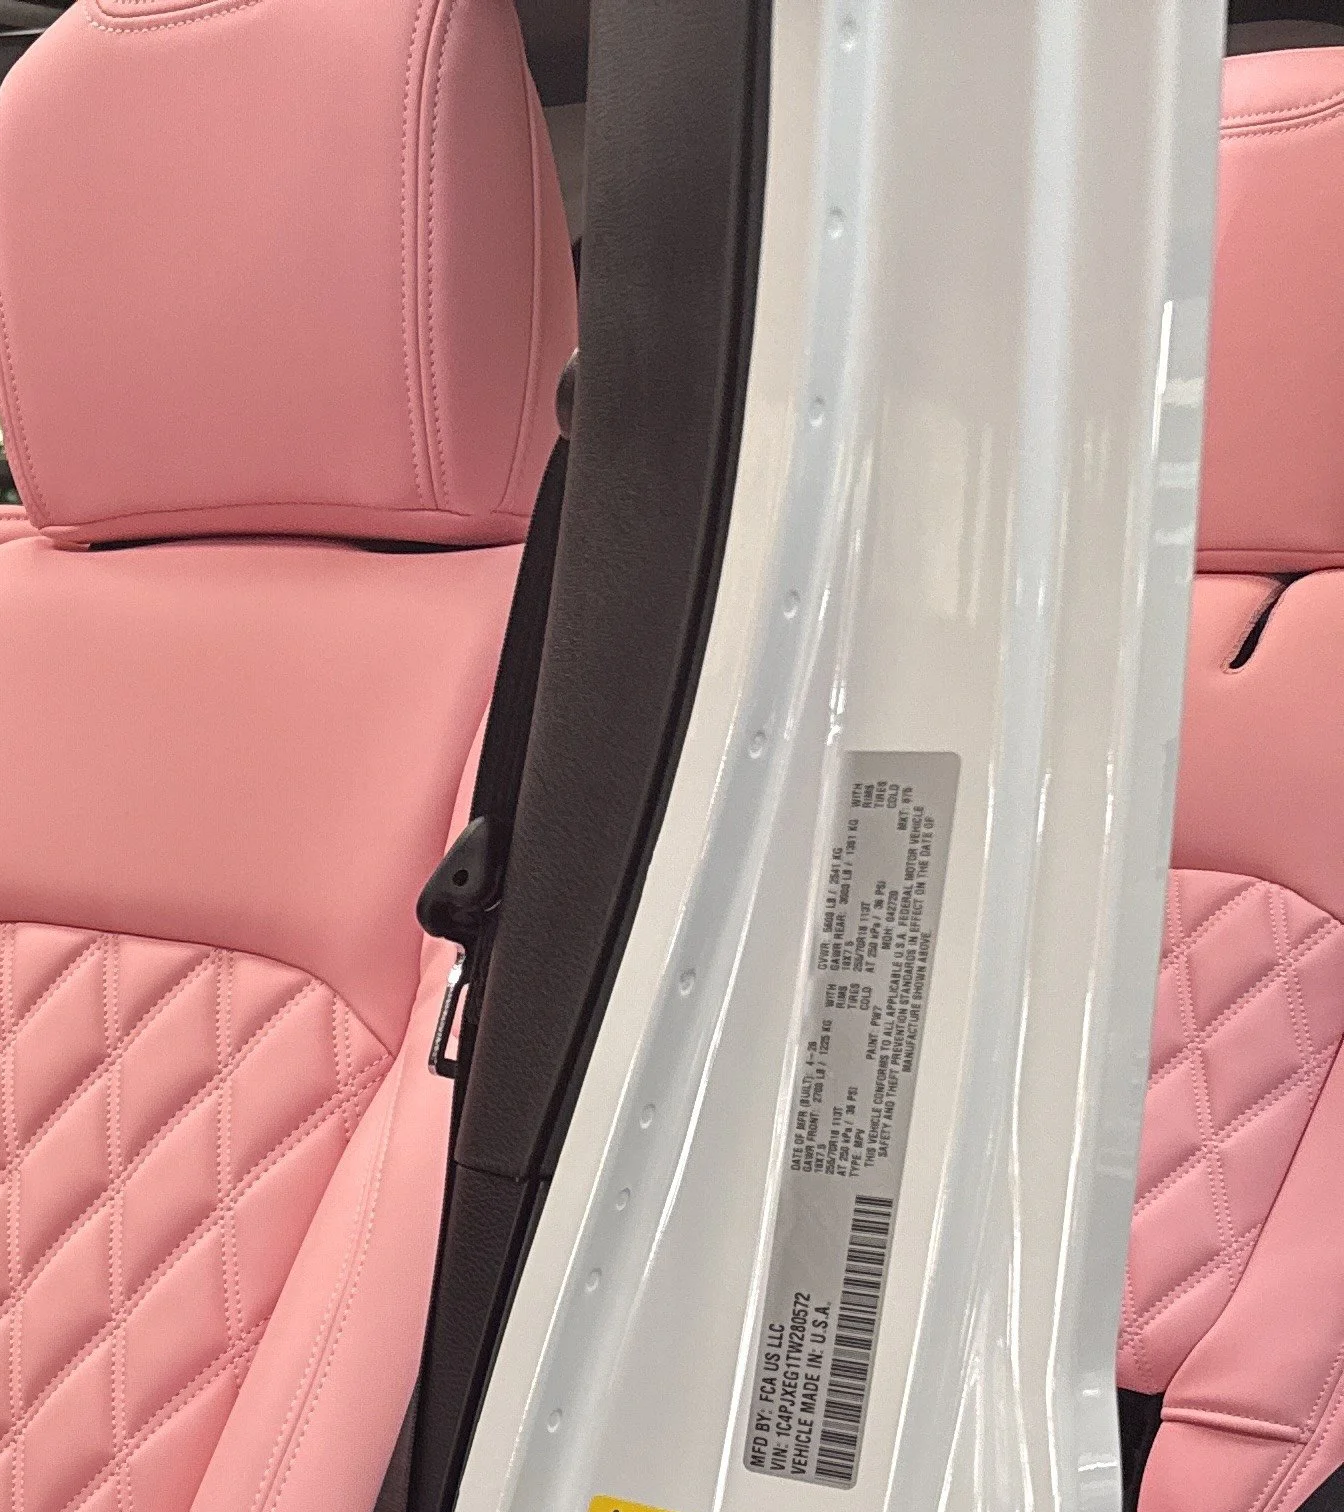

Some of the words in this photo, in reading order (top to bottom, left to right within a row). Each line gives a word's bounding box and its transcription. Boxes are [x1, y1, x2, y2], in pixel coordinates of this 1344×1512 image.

[909, 805, 923, 845] VEHICLE
[922, 815, 935, 829] OF
[919, 831, 931, 857] DATE
[904, 847, 917, 881] MOTOR
[916, 859, 928, 878] THE
[914, 880, 925, 895] ON
[898, 883, 912, 927] FEDERAL
[909, 898, 922, 933] EFFECT
[906, 935, 918, 946] IN
[885, 961, 901, 1017] APPLICABLE
[899, 949, 915, 1005] STANDARDS
[825, 983, 836, 1008] WITH
[836, 984, 846, 1008] RIMS
[821, 1018, 832, 1032] KG
[883, 1020, 893, 1037] ALL
[902, 1002, 920, 1072] MANUFACTURE
[912, 964, 925, 1000] SHOWN
[819, 1034, 829, 1055] 1225
[880, 1039, 892, 1052] TO
[891, 1007, 907, 1065] PREVENTION
[814, 1068, 825, 1079] LB
[873, 1054, 889, 1105] CONFORMS
[886, 1068, 899, 1098] THEFT
[796, 1110, 807, 1130] MFR
[883, 1100, 894, 1120] AND
[868, 1107, 881, 1144] VEHICLE
[793, 1133, 804, 1145] OF
[878, 1123, 891, 1157] SAFETY
[791, 1146, 801, 1171] DATE
[802, 1144, 813, 1172] GAWR
[865, 1146, 876, 1168] THIS
[811, 1300, 830, 1343] U.S.A.
[768, 1323, 784, 1347] LLC
[764, 1352, 780, 1370] US
[775, 1292, 810, 1437] 1C4PJXEG1TW280572
[807, 1348, 823, 1367] IN:
[760, 1376, 776, 1402] FCA
[800, 1373, 820, 1413] MADE
[755, 1408, 771, 1431] BY:
[750, 1437, 767, 1466] MFD
[770, 1442, 788, 1471] VIN:
[791, 1418, 813, 1475] VEHICLE
